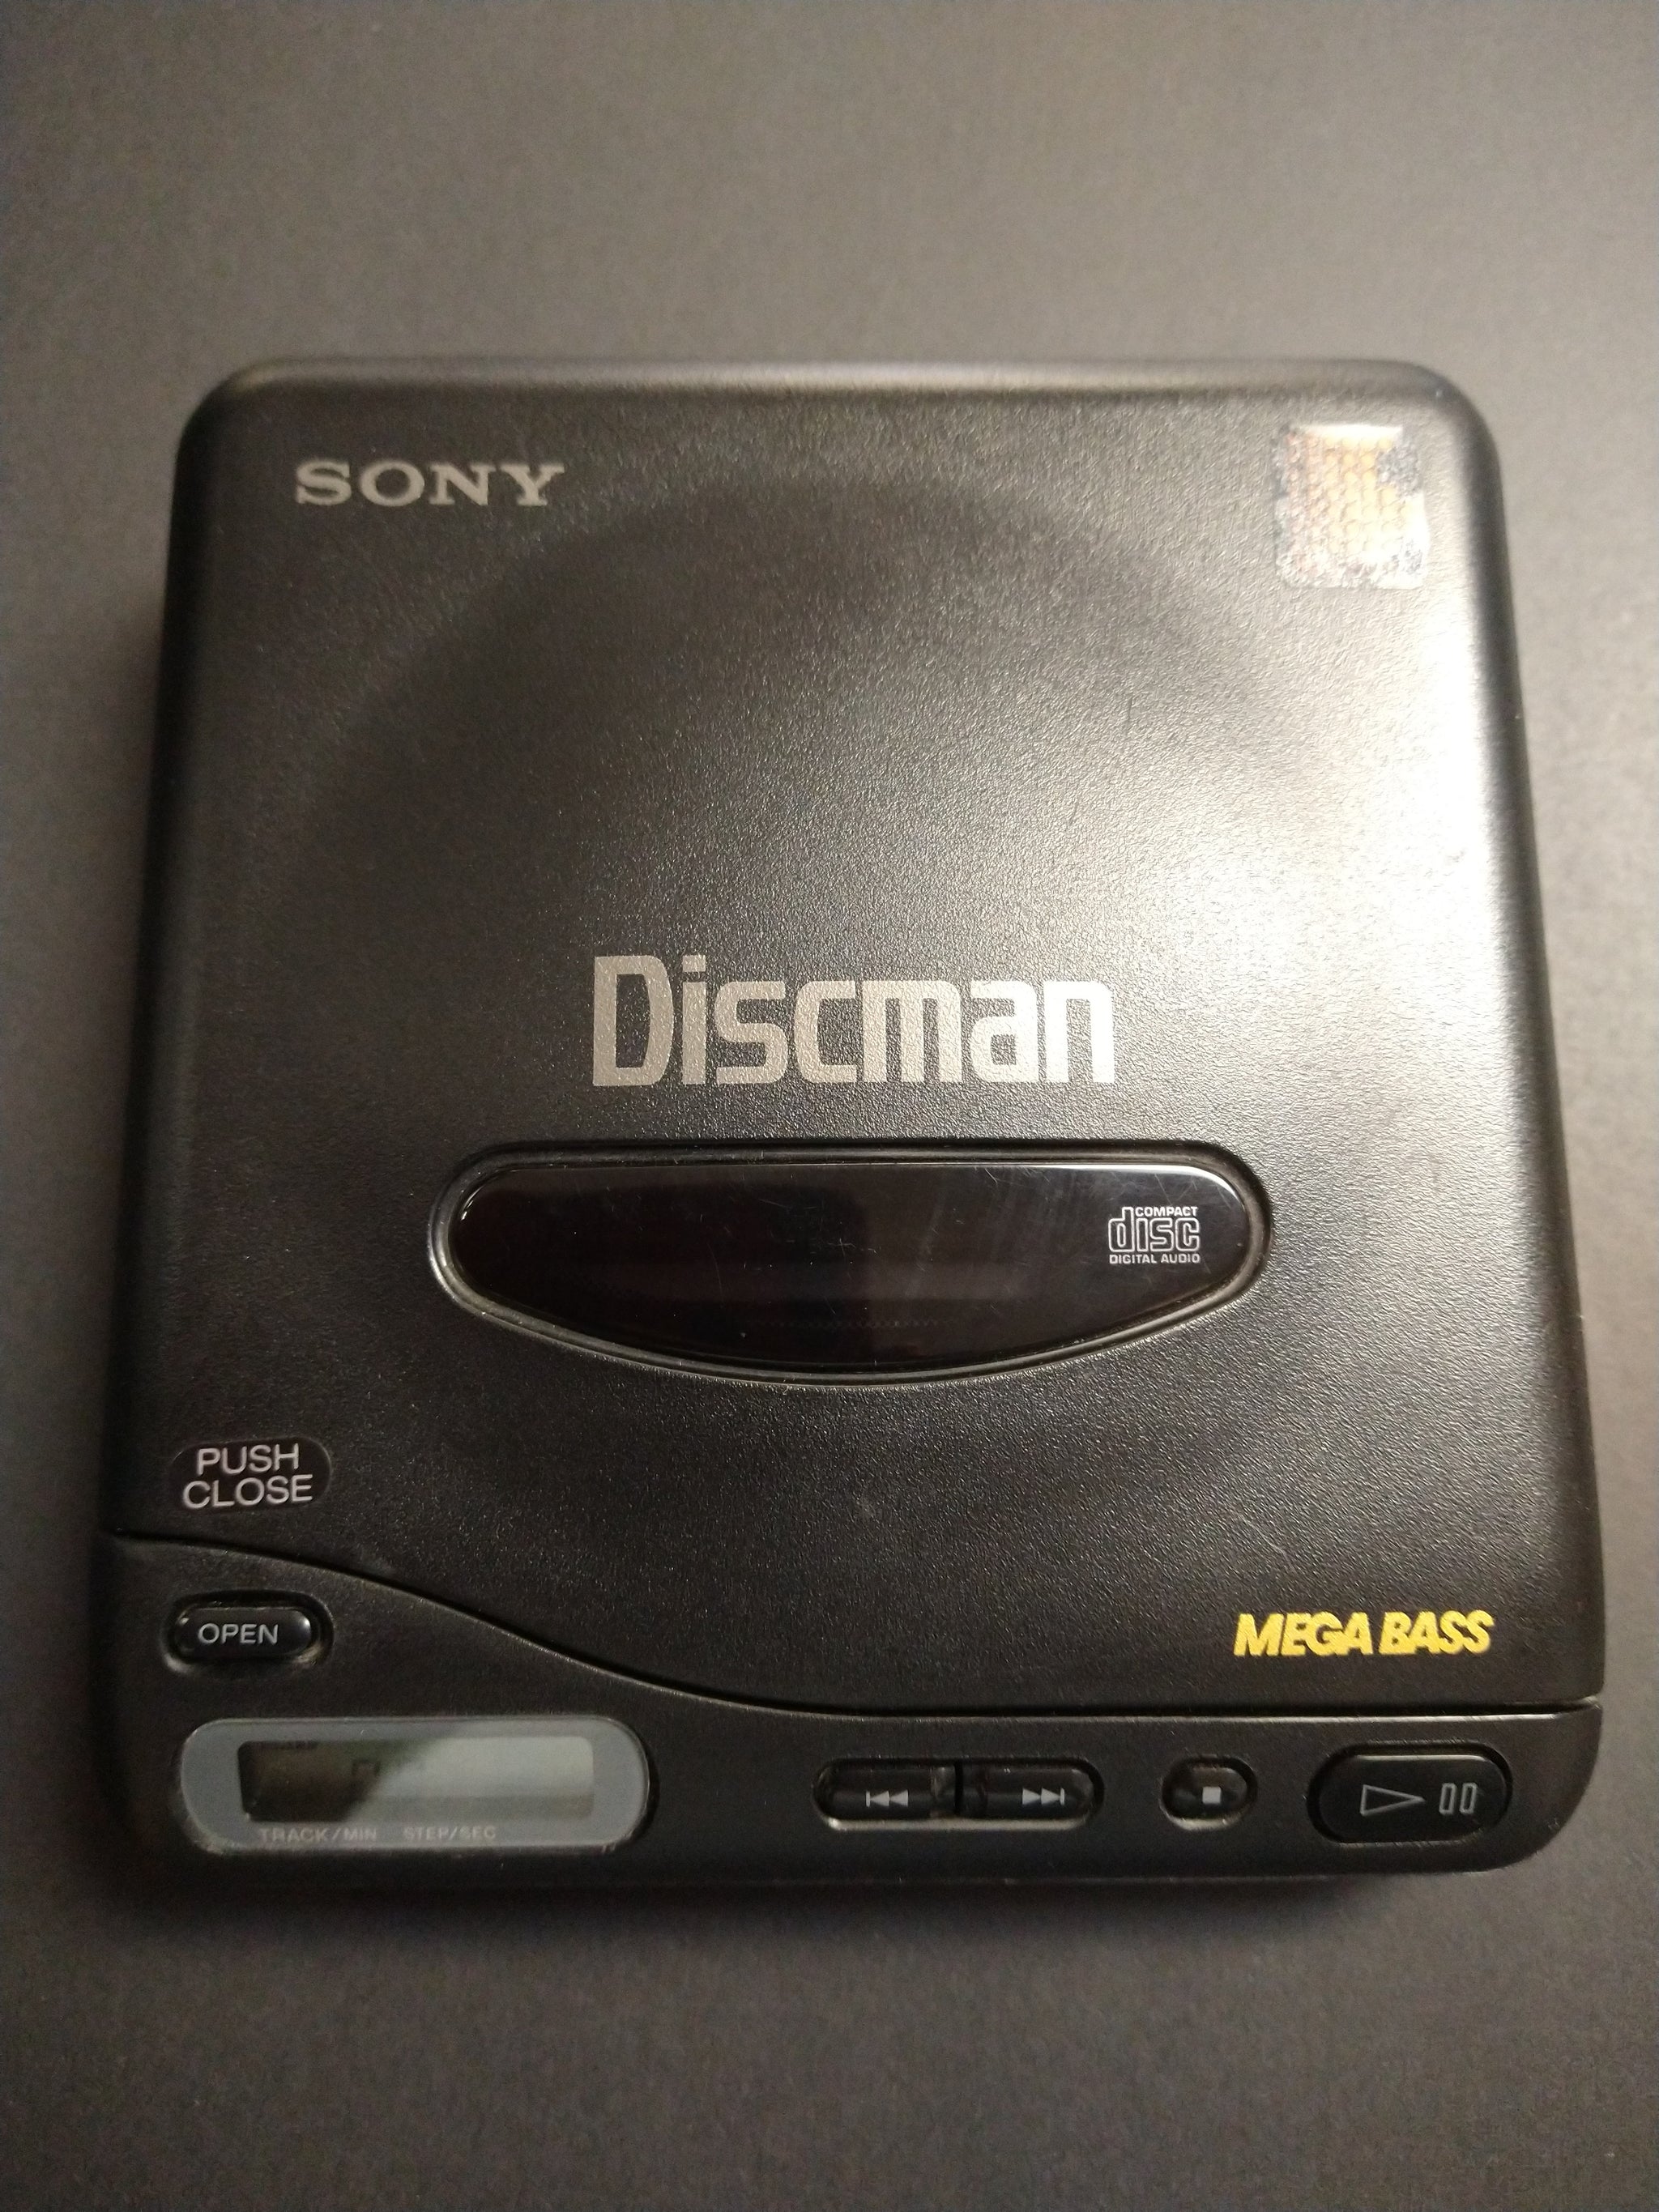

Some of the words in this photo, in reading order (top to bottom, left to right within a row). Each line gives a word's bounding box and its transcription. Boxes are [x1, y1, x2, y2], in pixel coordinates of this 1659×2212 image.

[295, 459, 565, 507] SONY
[592, 954, 1115, 1087] Discman
[1108, 1206, 1200, 1252] disc
[1135, 1206, 1198, 1217] COMPACT
[1109, 1254, 1158, 1264] DIGITAL
[1161, 1253, 1201, 1264] AUDIO
[197, 1443, 300, 1476] PUSH
[182, 1473, 313, 1510] CLOSE
[198, 1622, 279, 1645] OPEN
[1233, 1610, 1373, 1656] MEGA
[1378, 1609, 1495, 1655] BASS
[259, 1826, 377, 1843] TRACK/MIN
